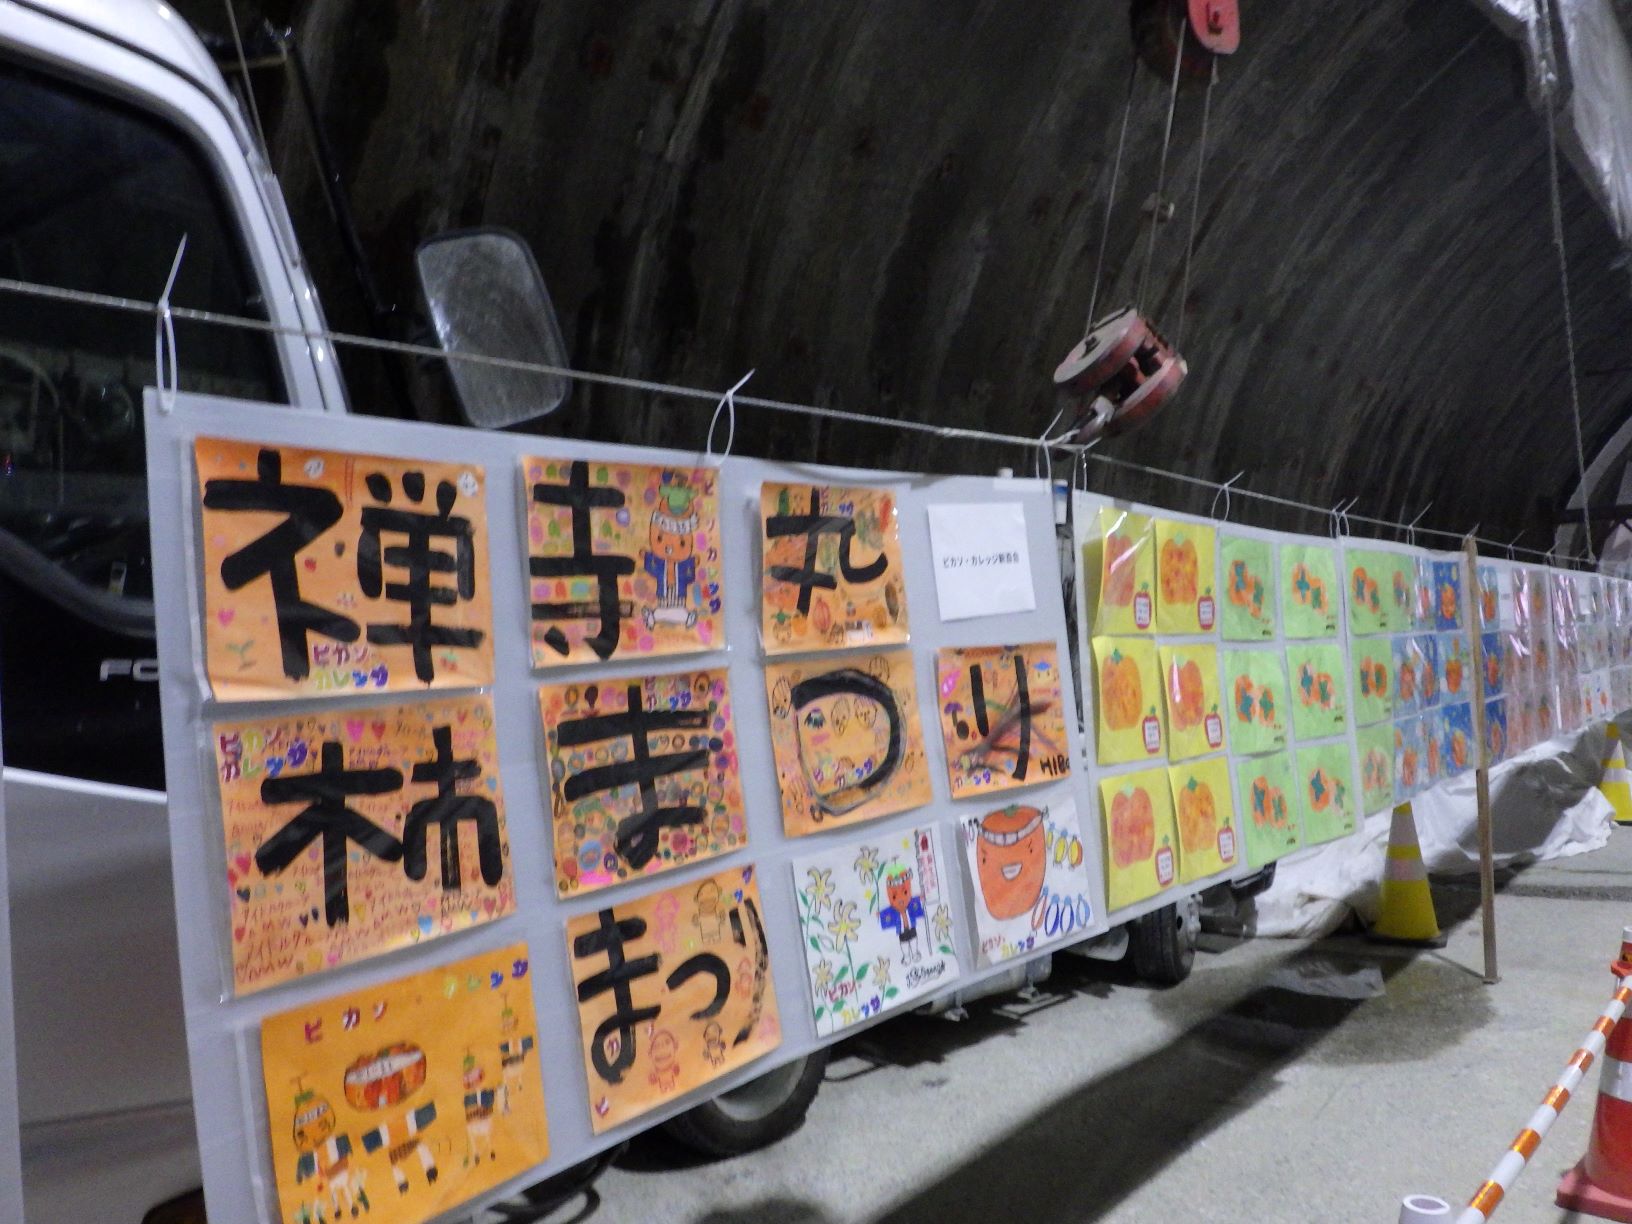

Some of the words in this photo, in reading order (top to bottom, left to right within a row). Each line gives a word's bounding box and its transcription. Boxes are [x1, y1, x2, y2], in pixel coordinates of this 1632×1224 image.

[203, 448, 485, 687] 禅
[530, 460, 635, 660] 寺
[255, 725, 503, 927] 柿
[557, 685, 709, 870] ま
